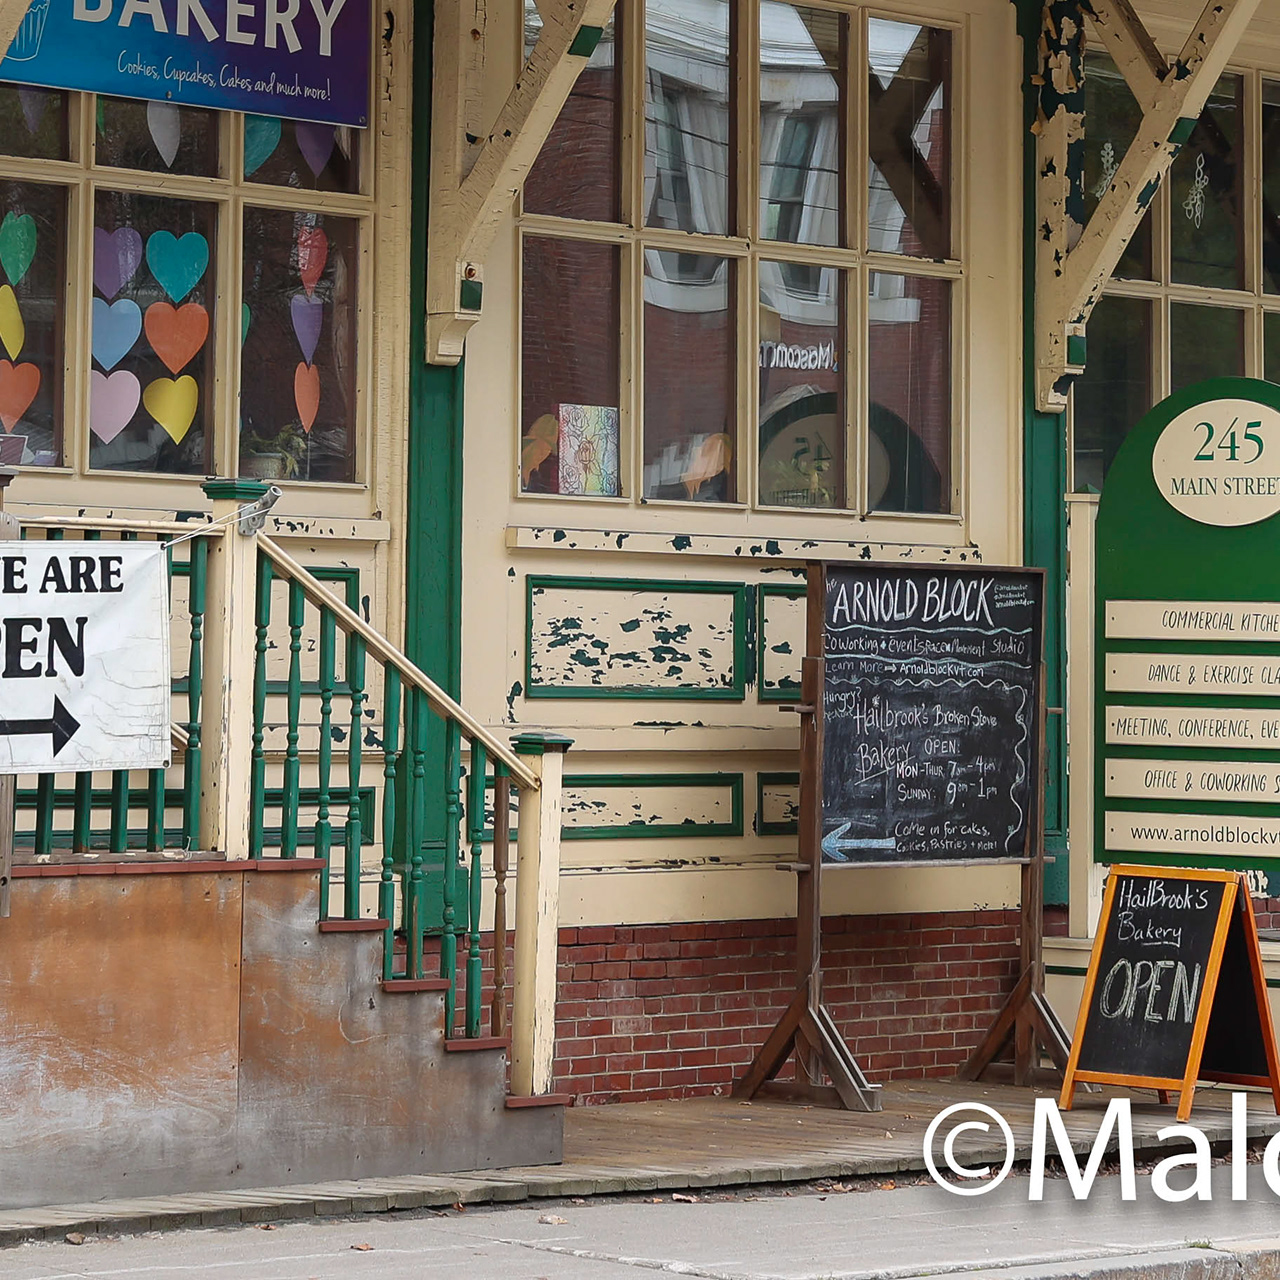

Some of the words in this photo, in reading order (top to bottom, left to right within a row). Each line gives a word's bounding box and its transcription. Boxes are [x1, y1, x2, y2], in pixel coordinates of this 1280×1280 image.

[117, 49, 161, 81] Cookies,
[163, 56, 217, 92] Cupcakes,
[219, 64, 253, 89] Cakes
[254, 71, 276, 93] and
[276, 73, 303, 97] much
[304, 78, 331, 101] more!
[1192, 417, 1265, 465] 245
[1170, 477, 1218, 496] MAIN
[39, 556, 125, 594] ARE
[832, 578, 919, 624] ARNOLD
[921, 577, 995, 627] BLOCK
[1162, 609, 1236, 632] COMMERCIAL
[825, 660, 855, 673] Learn
[859, 661, 884, 674] More
[1148, 664, 1181, 683] DANCE
[1188, 665, 1197, 685] &
[1204, 664, 1254, 685] EXERCISE
[823, 686, 862, 713] Hungry?
[933, 704, 970, 727] Broken
[970, 705, 998, 727] Stove
[1116, 718, 1172, 738] MEETING,
[1178, 719, 1254, 740] CONFERENCE,
[856, 740, 912, 774] Bakery
[924, 738, 961, 755] OPEN:
[1144, 770, 1178, 789] OFFICE
[1184, 771, 1193, 791] &
[1200, 771, 1267, 793] COWORKING
[1117, 911, 1183, 947] Bakery
[1099, 957, 1202, 1024] OPEN
